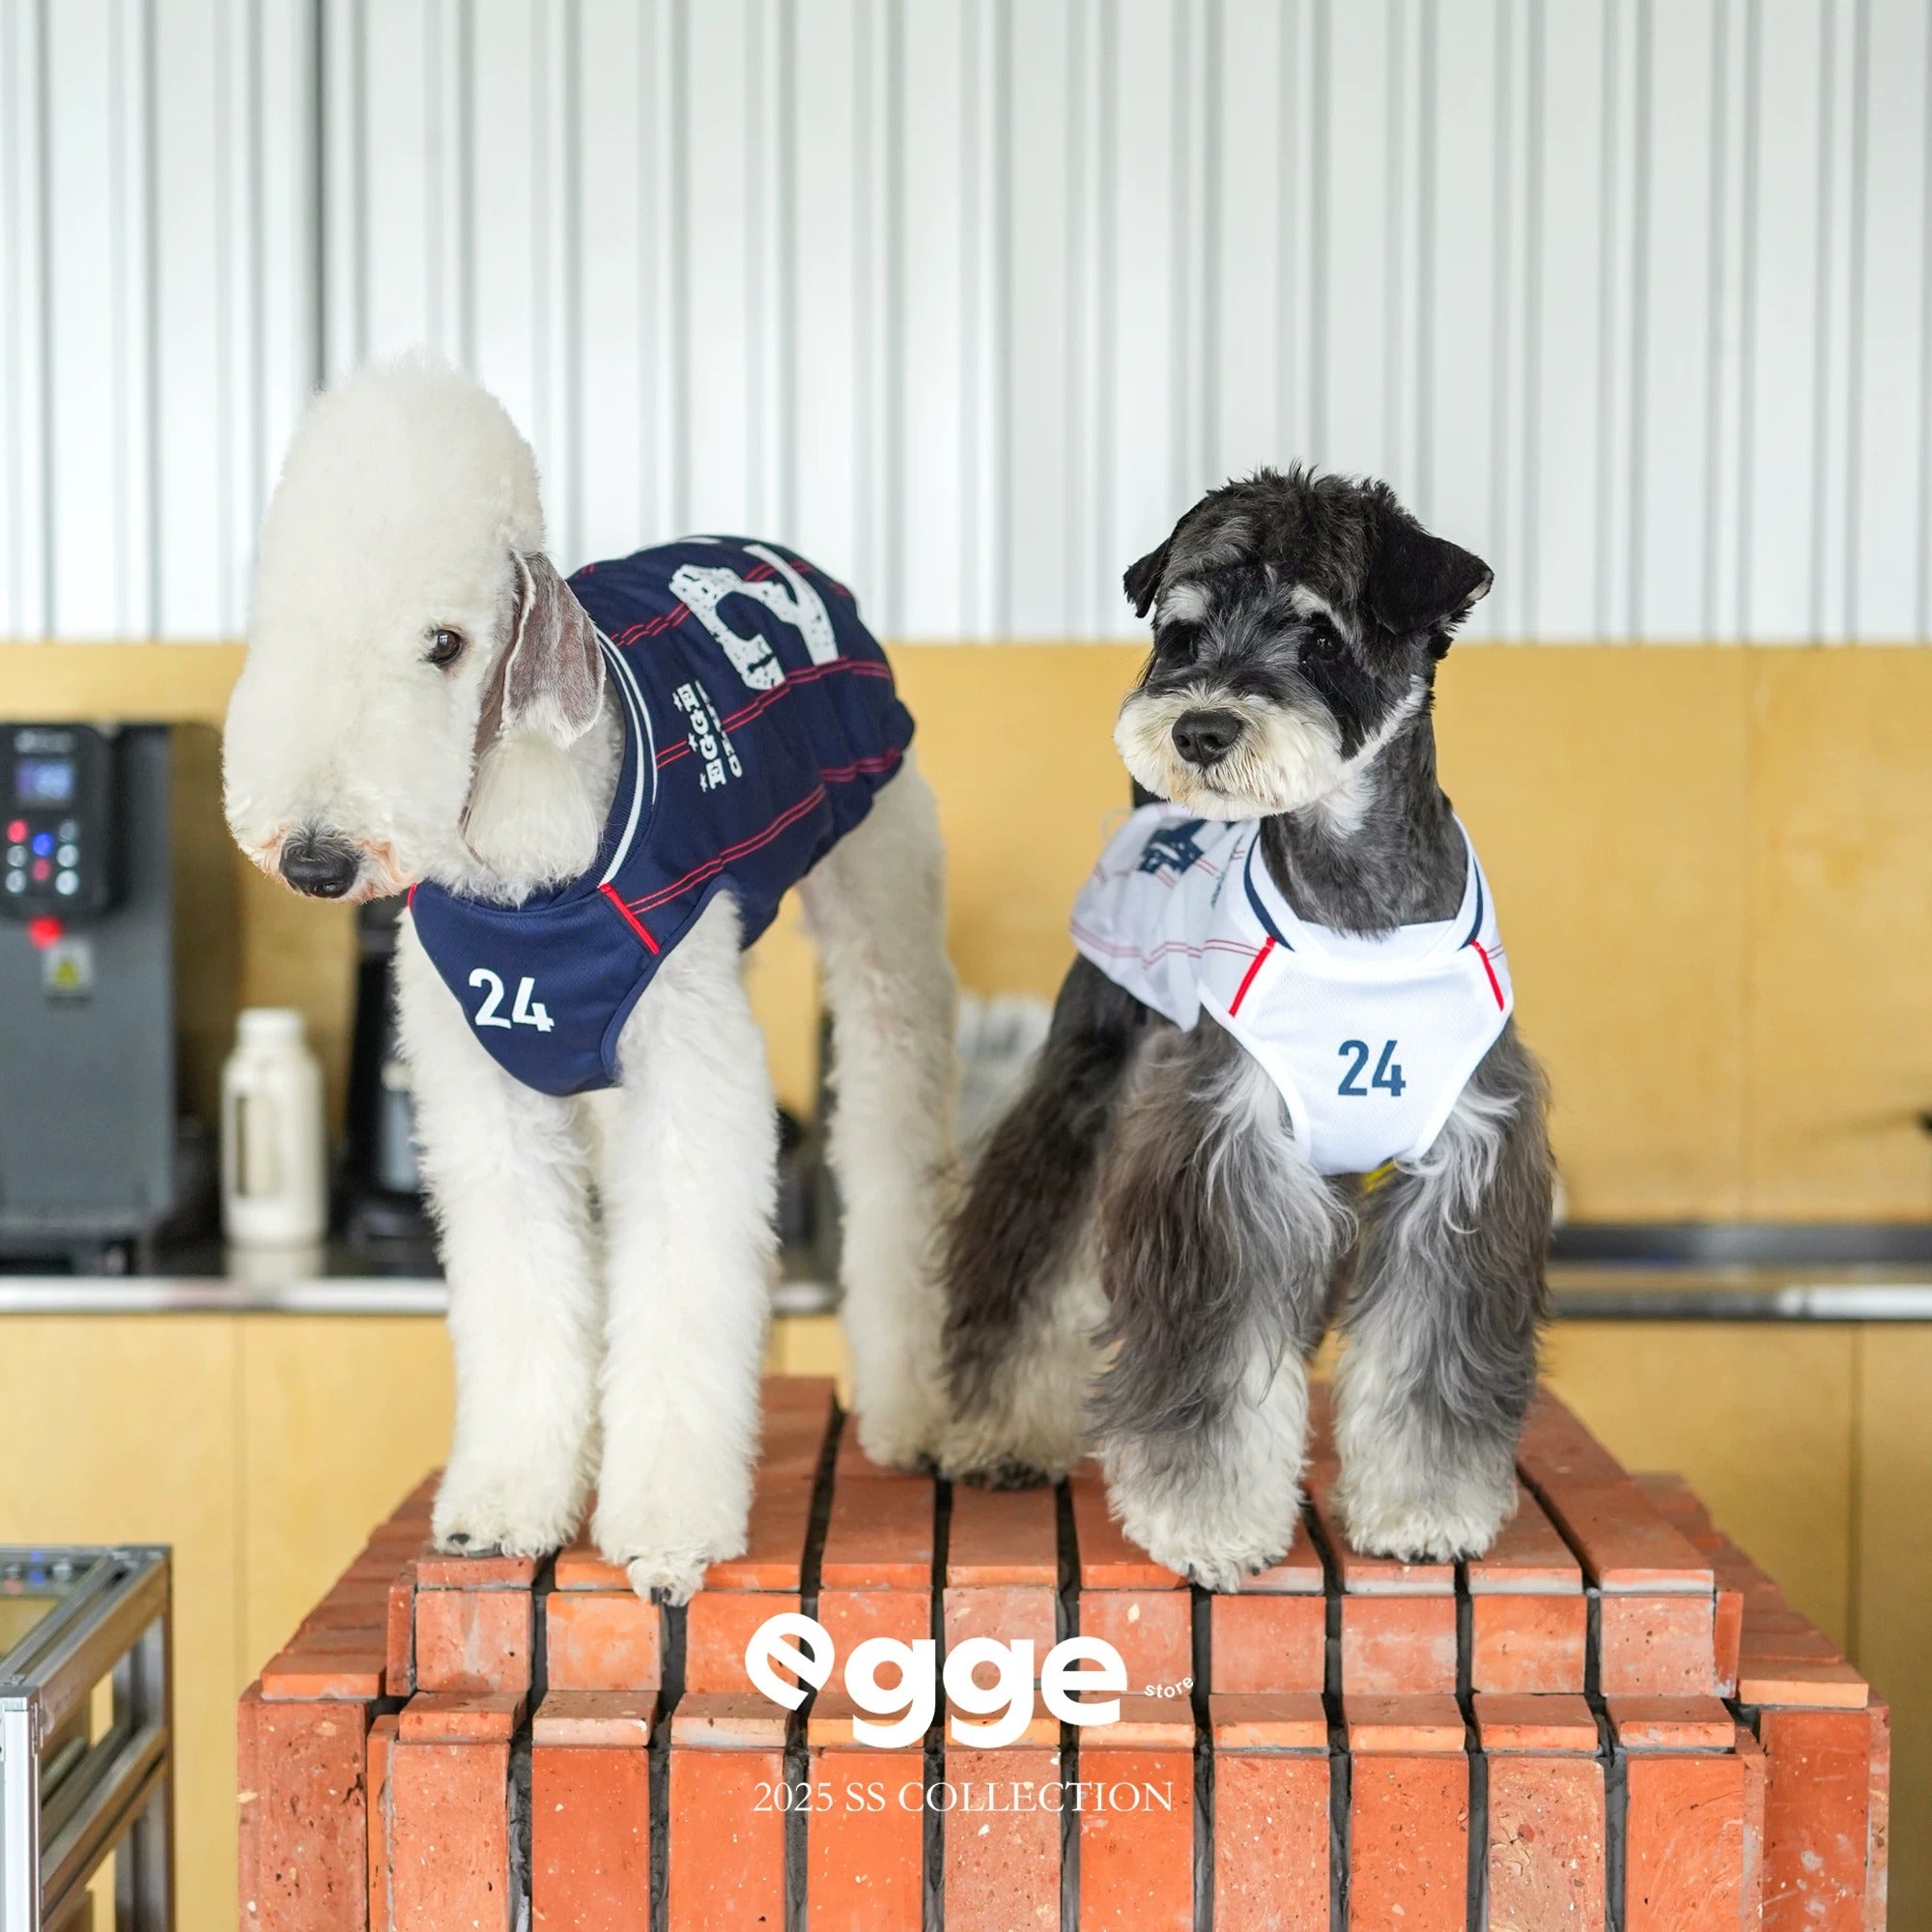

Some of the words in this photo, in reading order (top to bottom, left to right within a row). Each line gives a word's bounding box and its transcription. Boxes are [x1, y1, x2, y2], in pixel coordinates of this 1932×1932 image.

[668, 537, 839, 691] 2
[676, 683, 726, 790] EGGE
[469, 968, 554, 1033] 24
[1338, 1039, 1406, 1097] 24
